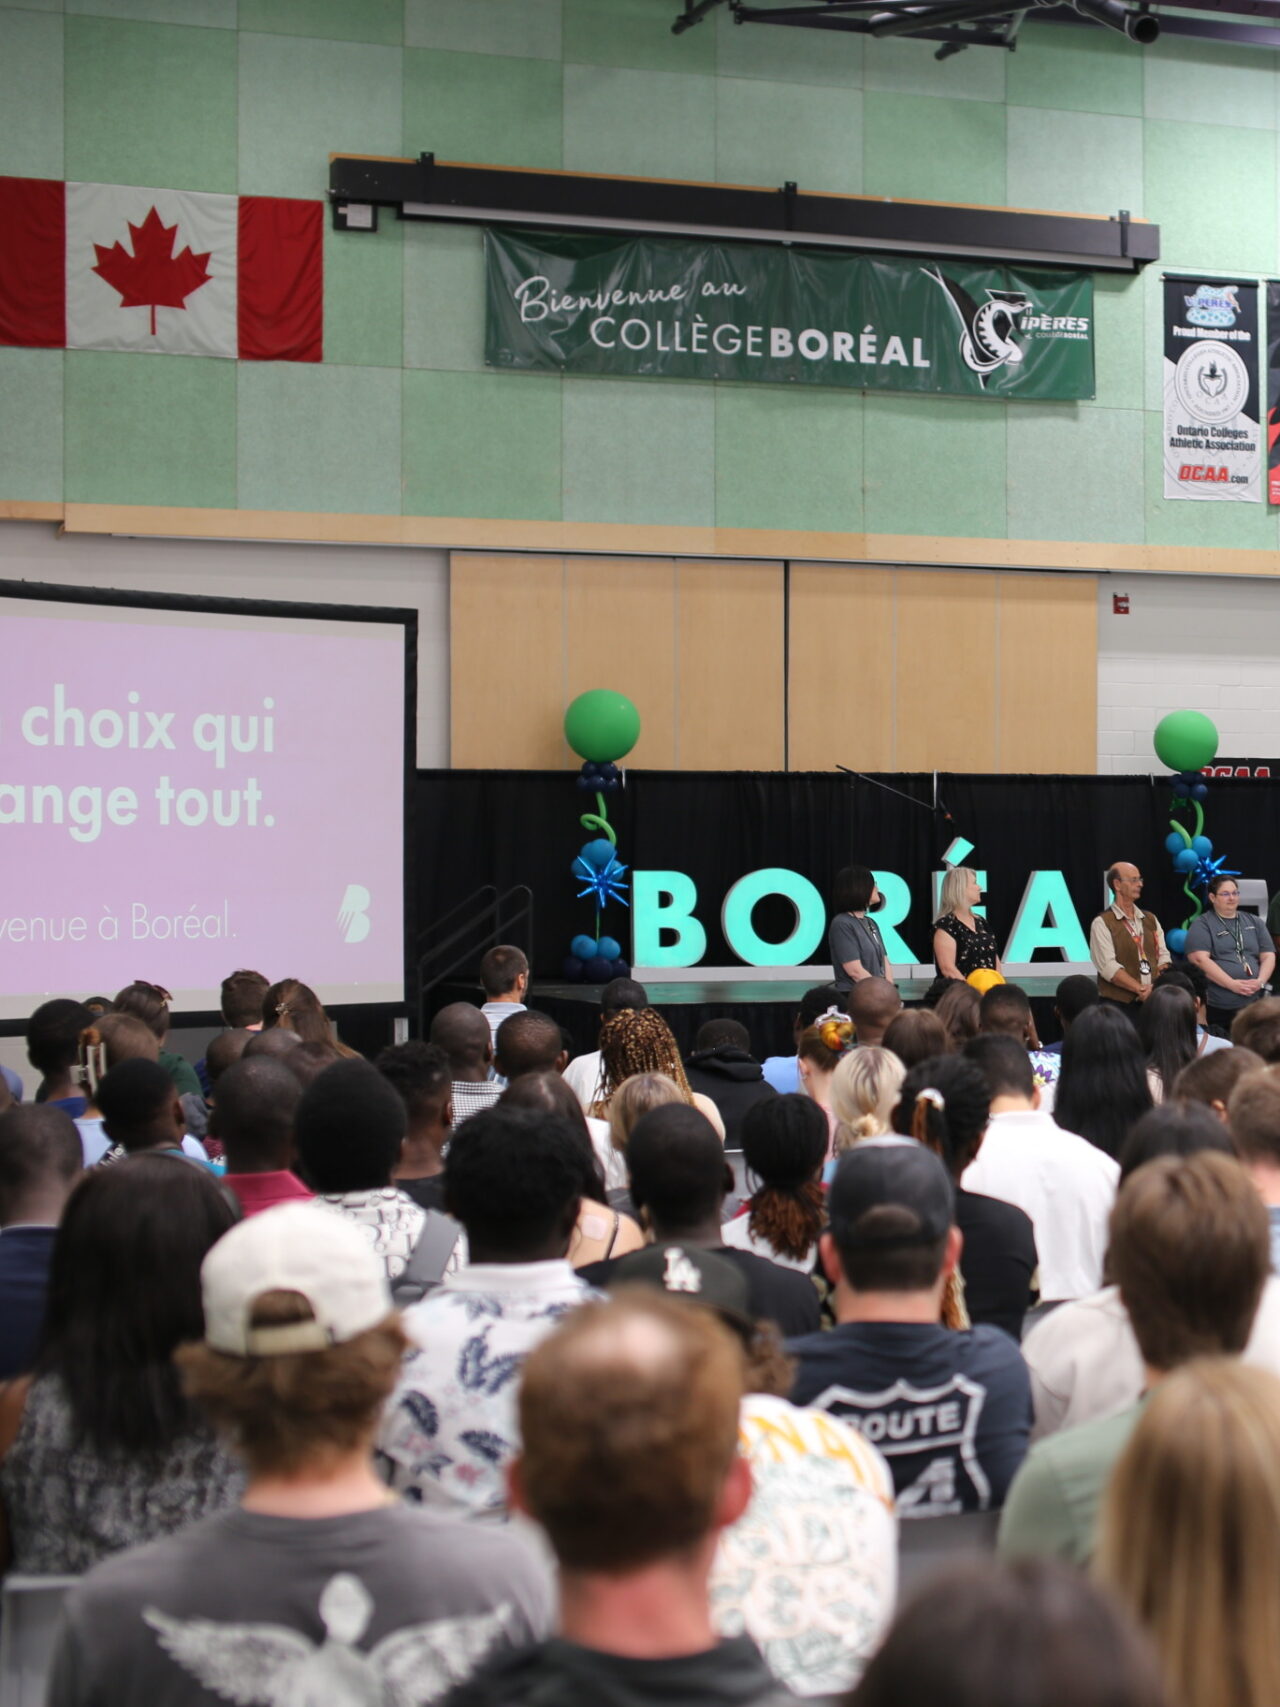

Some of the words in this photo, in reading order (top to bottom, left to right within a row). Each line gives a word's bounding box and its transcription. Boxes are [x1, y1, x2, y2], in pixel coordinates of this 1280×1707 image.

[514, 276, 686, 322] Bienvenue
[702, 281, 747, 297] au
[1169, 436, 1204, 449] Athletic
[1205, 439, 1256, 452] Association
[1177, 424, 1209, 437] Ontario
[1210, 426, 1249, 440] Colleges
[21, 683, 176, 749] choix
[193, 697, 275, 769] qui
[155, 776, 275, 827] tout.
[98, 904, 118, 940] à
[132, 898, 237, 940] Boréal.
[630, 836, 1115, 968] BORA
[664, 1247, 702, 1293] LA
